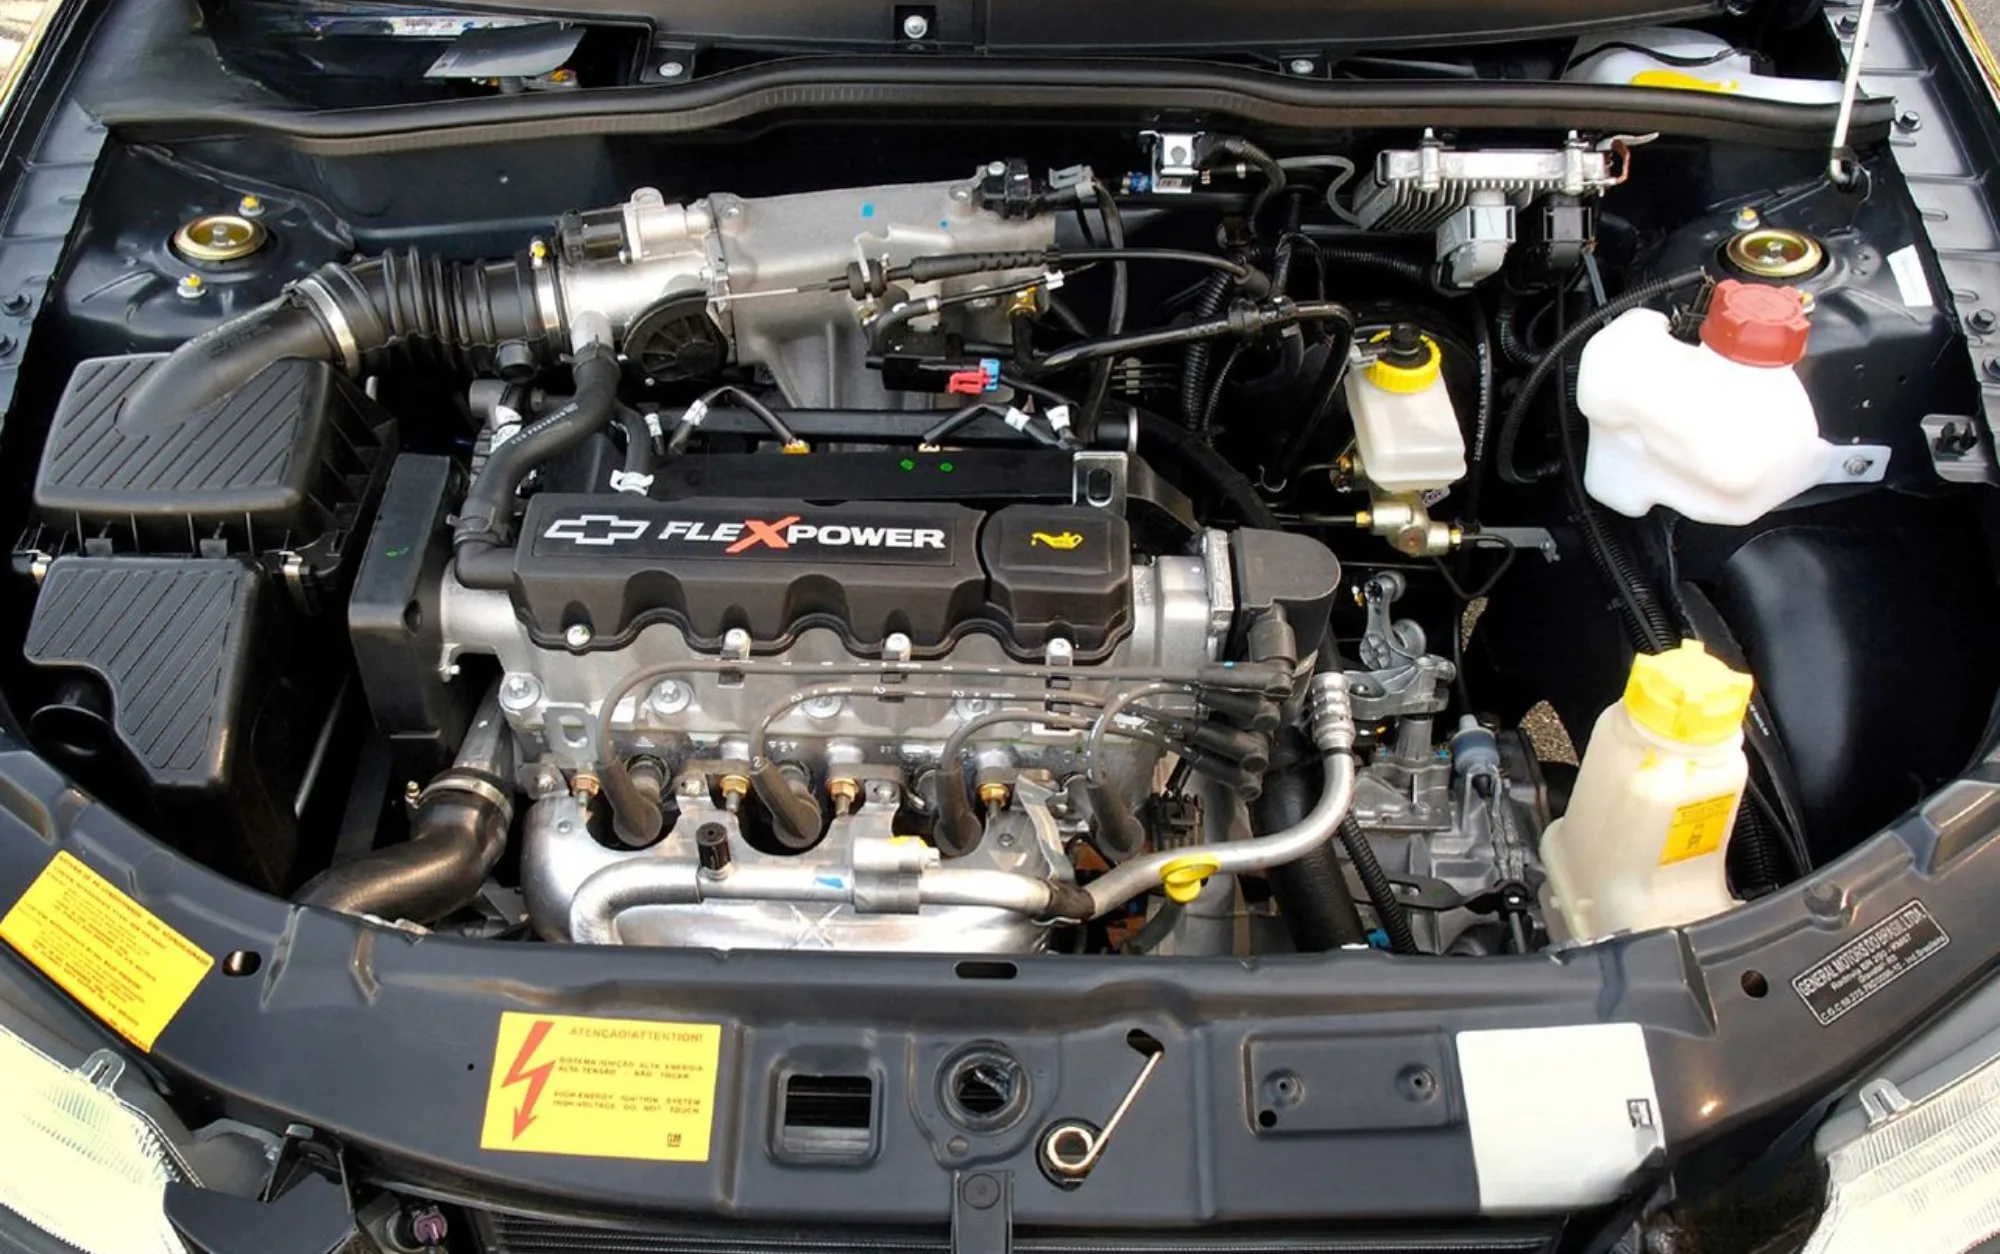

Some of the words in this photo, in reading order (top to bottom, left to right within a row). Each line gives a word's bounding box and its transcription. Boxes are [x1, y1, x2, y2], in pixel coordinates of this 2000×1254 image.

[1798, 963, 1838, 997] GENERAL
[1832, 942, 1869, 971] MOTORS
[1864, 935, 1881, 952] DO
[1876, 918, 1906, 945] BRASIL
